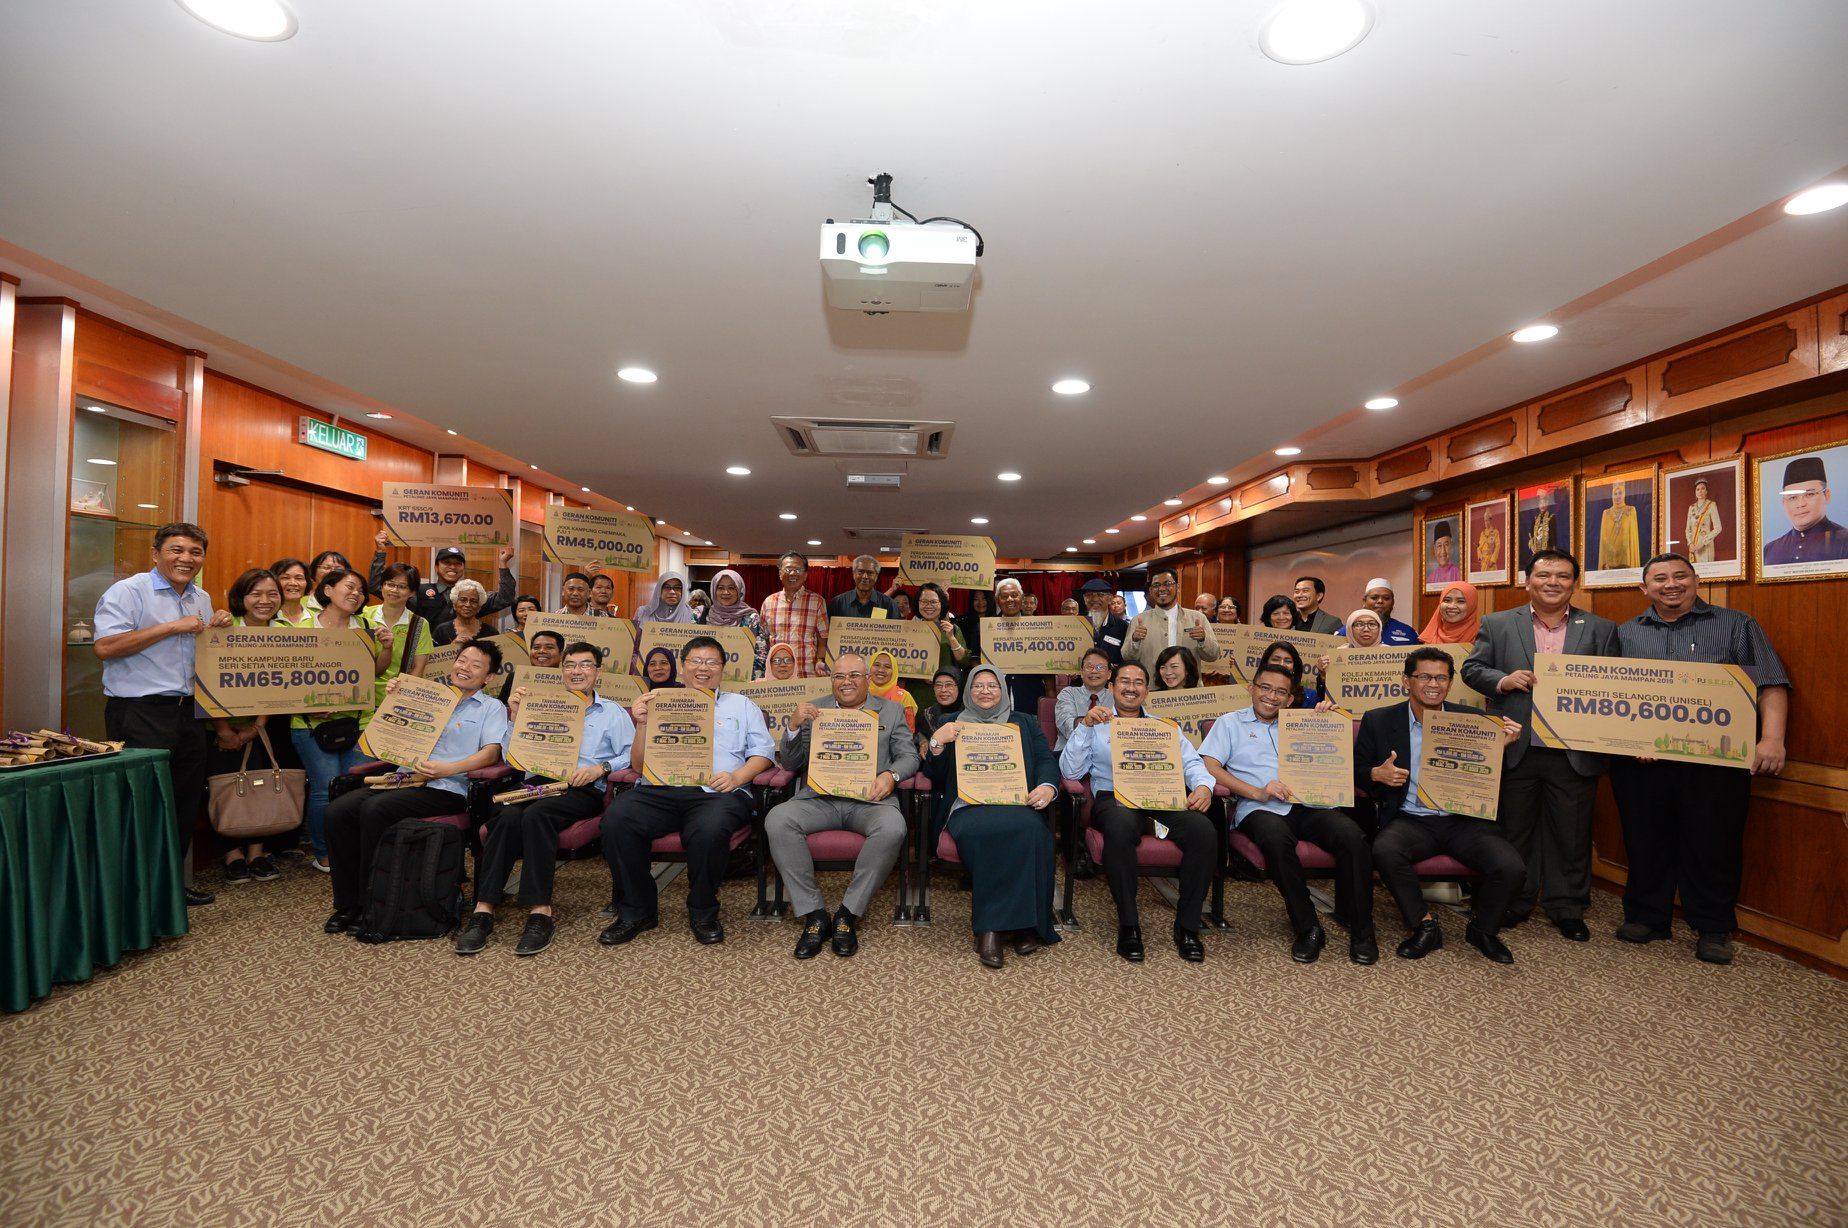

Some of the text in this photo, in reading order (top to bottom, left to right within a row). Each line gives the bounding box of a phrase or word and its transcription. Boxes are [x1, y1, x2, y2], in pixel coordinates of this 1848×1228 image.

[308, 421, 354, 454] KELUAR
[431, 490, 469, 498] KOMUNITI
[398, 511, 494, 526] RM13,670.00
[585, 514, 617, 523] KOMUNITI
[572, 526, 597, 534] KAMPUNG
[557, 535, 643, 554] RM45,000.00
[909, 560, 979, 572] RM11,000.00
[684, 628, 717, 636] KOMUNITI
[1254, 631, 1316, 644] GERAN KOMUNITI
[226, 635, 318, 643] GERAN KOMUNITI
[871, 635, 907, 643] PEMASTAUTIN
[993, 641, 1075, 653] RM5,400.00
[1348, 653, 1377, 662] GERAN
[240, 662, 265, 670] SETIA
[1565, 663, 1674, 679] GERAN KOMUNITI
[219, 669, 360, 689] RM65,800.00
[535, 673, 562, 681] GERAN
[1565, 672, 1598, 680] PETALING
[1621, 675, 1656, 683] MAMPAN
[399, 688, 452, 704] GERAN KOMUNITI
[740, 685, 806, 696] GERAN KOMUNITI
[1151, 693, 1216, 705] GERAN KOMUNITI
[1556, 688, 1712, 707] UNIVERSITI SELANGOR (UNISEL)
[1556, 695, 1732, 726] RM80,600.00
[1431, 725, 1497, 737] GERAN KOMUNITI
[1448, 722, 1480, 730] TAWARAN
